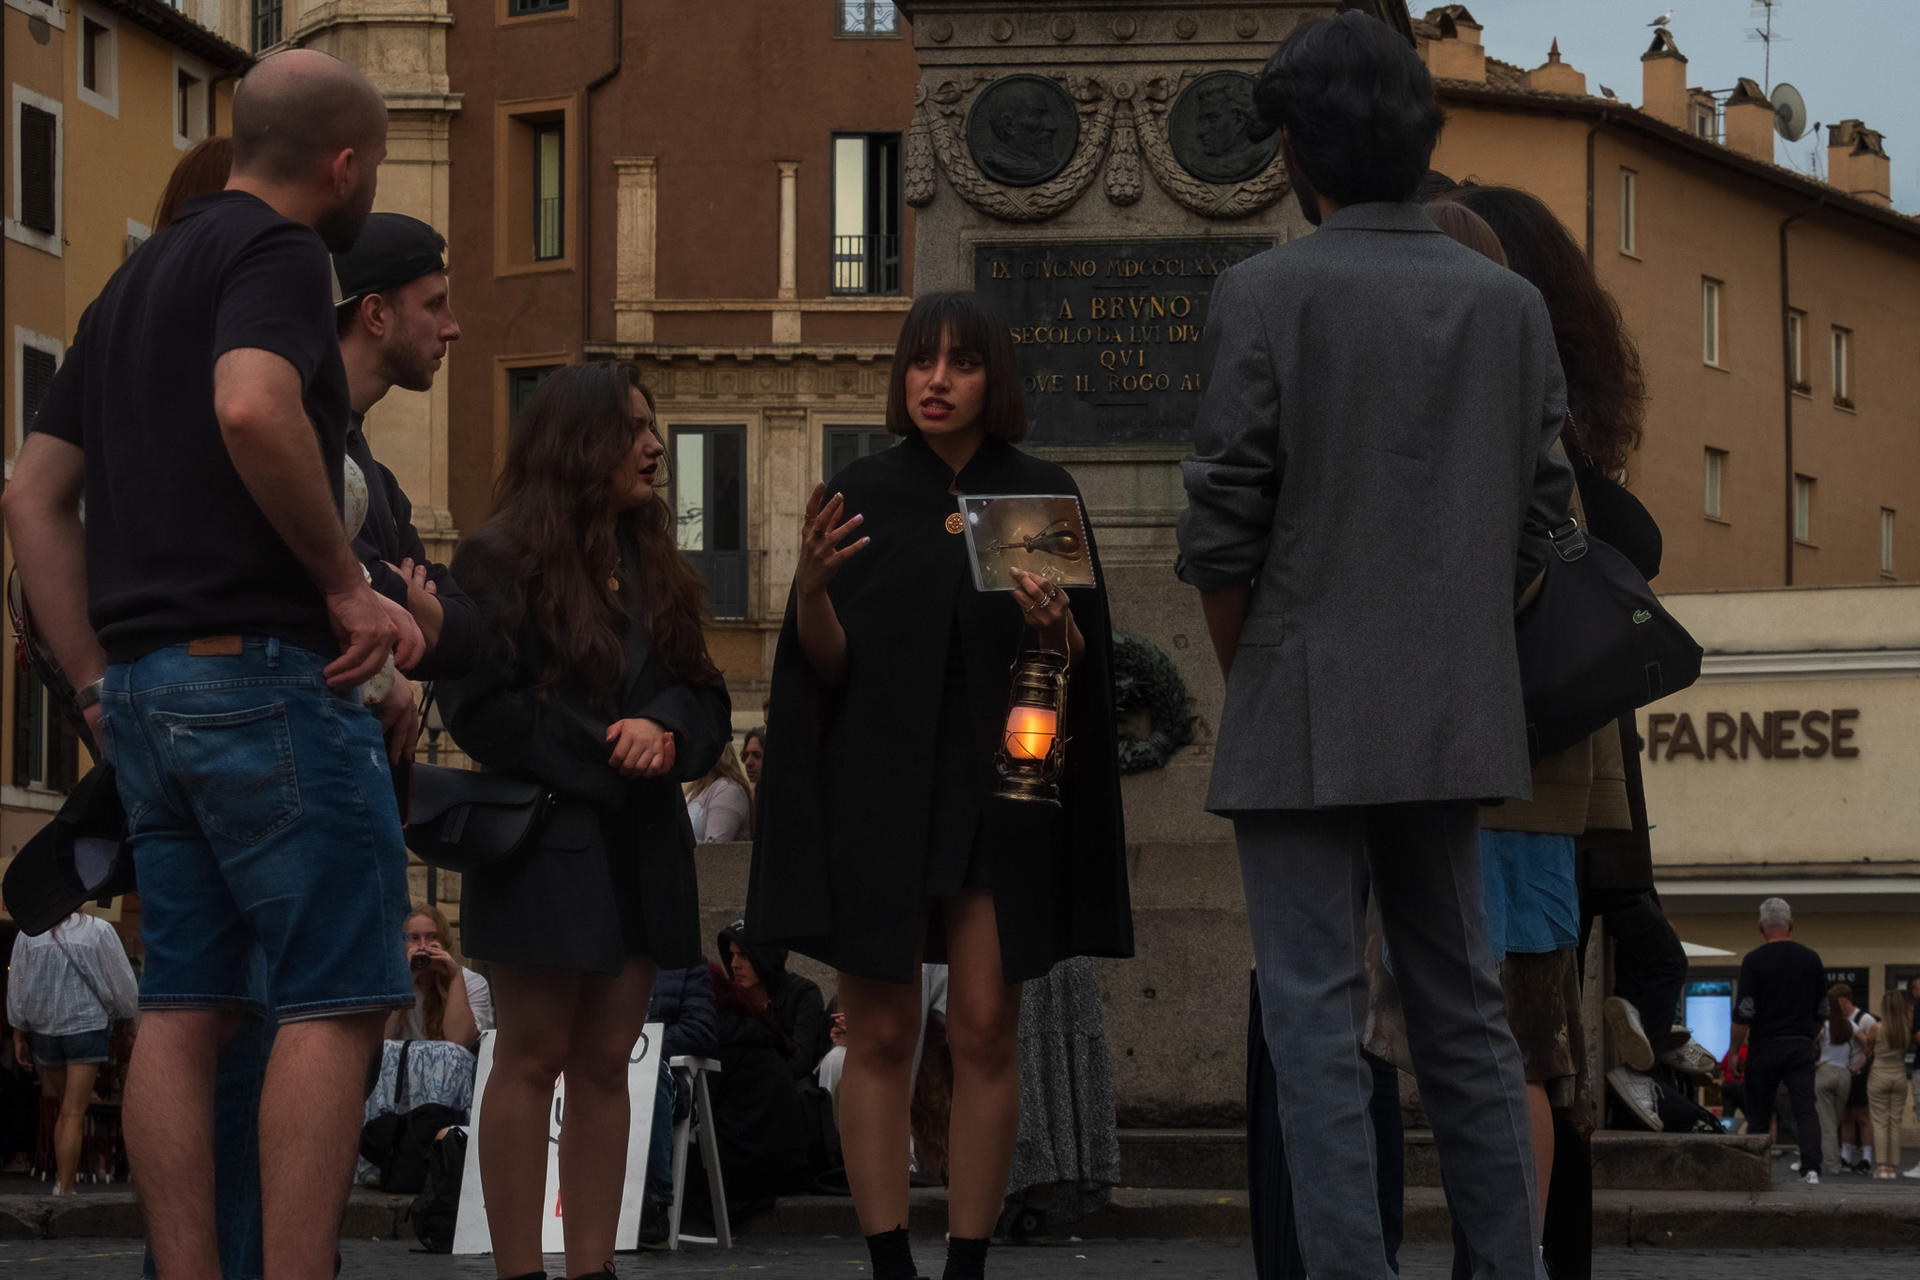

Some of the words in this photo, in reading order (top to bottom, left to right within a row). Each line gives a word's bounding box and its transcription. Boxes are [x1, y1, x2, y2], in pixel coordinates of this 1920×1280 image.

[1057, 297, 1076, 321] A
[1090, 295, 1192, 320] BRVNO
[1009, 326, 1092, 345] SECOLO
[1096, 326, 1123, 345] DA
[1100, 349, 1145, 371] QVI
[1023, 374, 1065, 393] OVE
[1648, 709, 1860, 761] FARNESE
